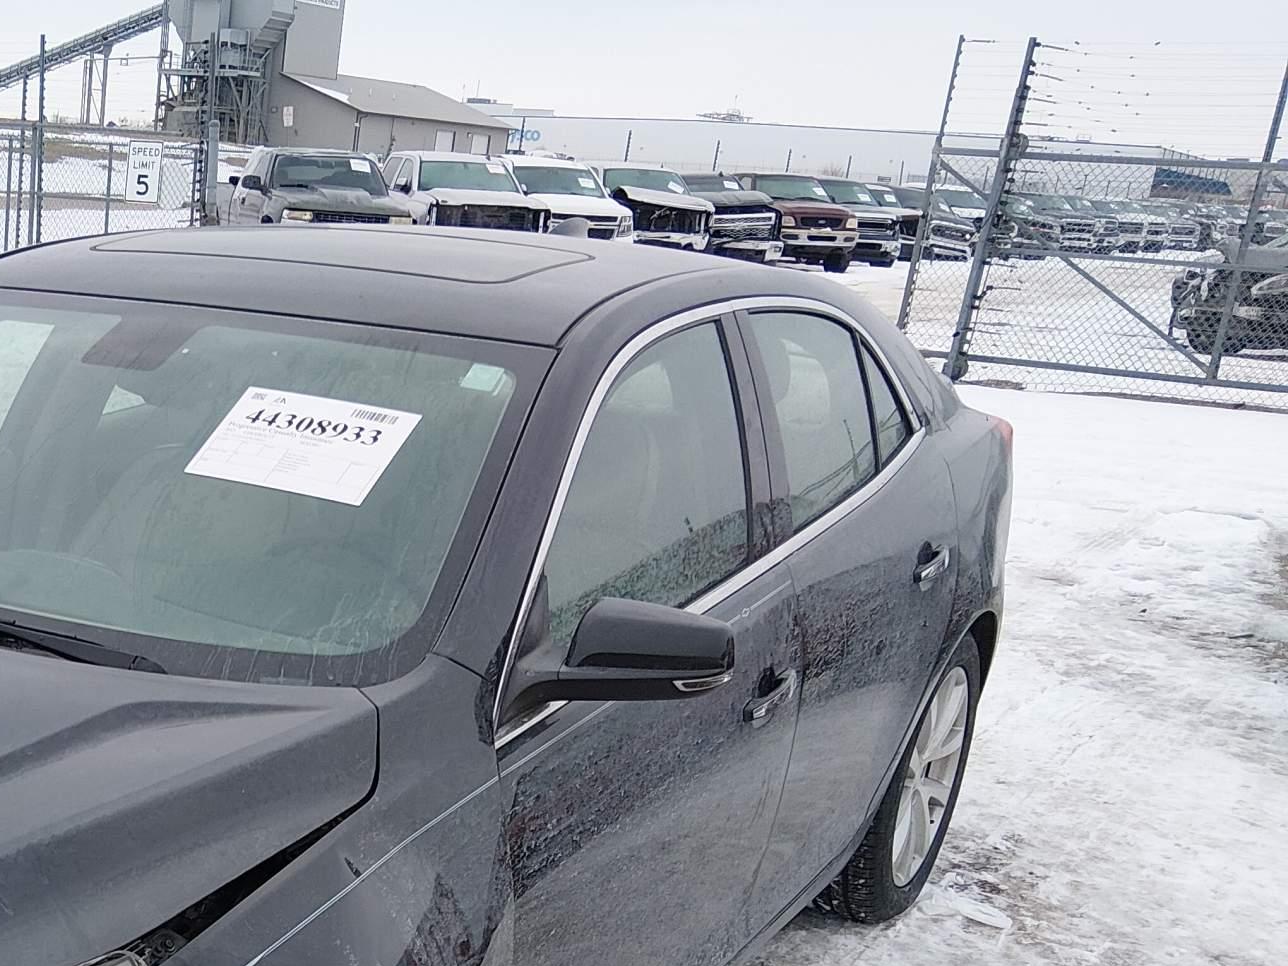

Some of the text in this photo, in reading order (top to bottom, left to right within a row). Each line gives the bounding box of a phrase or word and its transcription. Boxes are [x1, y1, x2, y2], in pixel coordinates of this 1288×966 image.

[131, 147, 160, 157] SPEED
[133, 160, 156, 170] LIMIT
[136, 174, 149, 196] 5
[245, 408, 383, 446] 44308933
